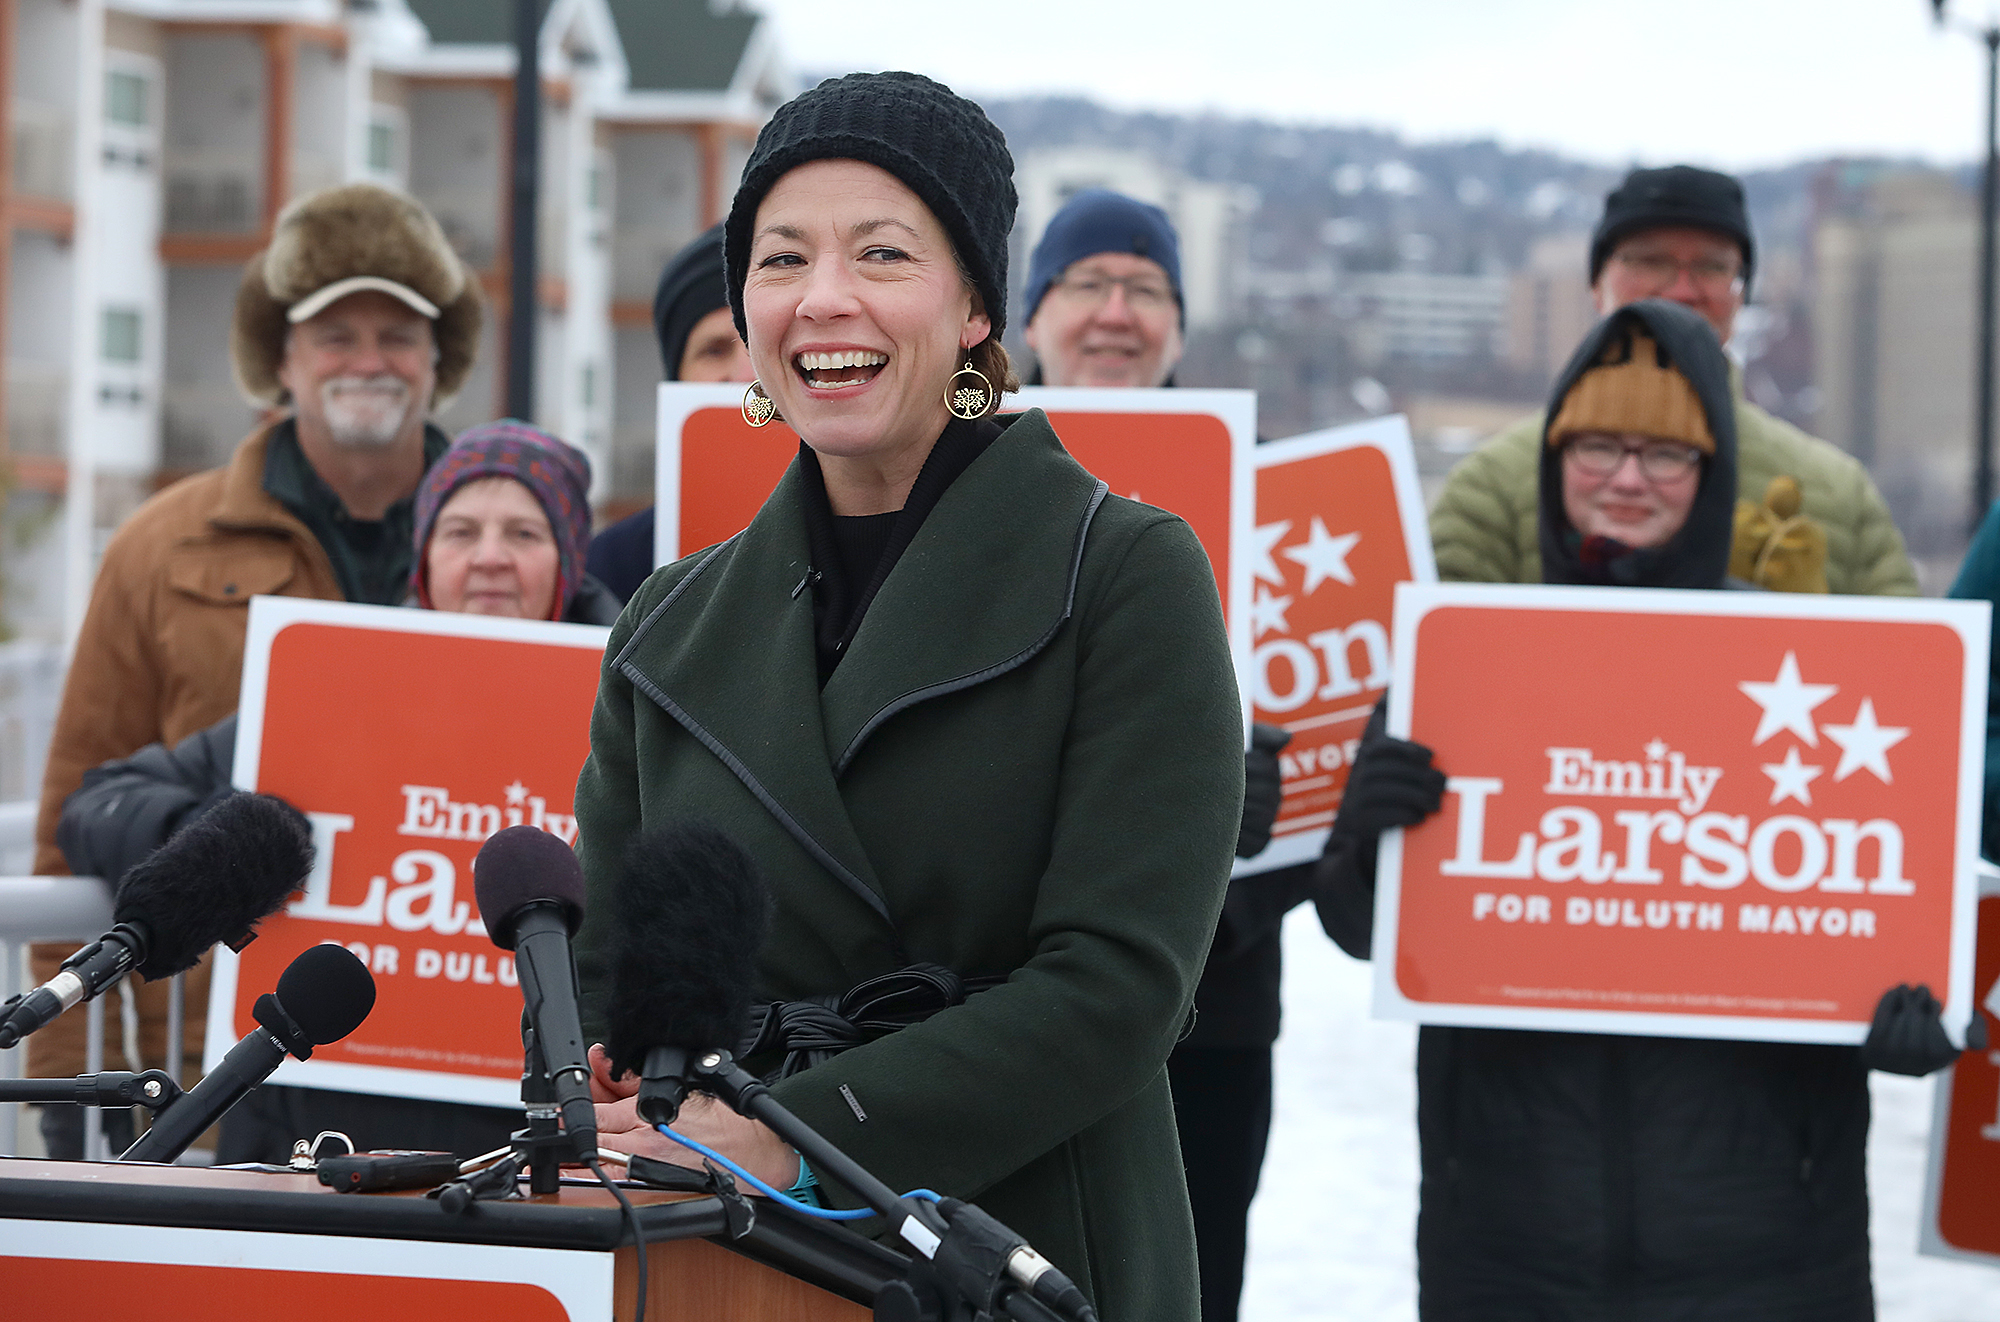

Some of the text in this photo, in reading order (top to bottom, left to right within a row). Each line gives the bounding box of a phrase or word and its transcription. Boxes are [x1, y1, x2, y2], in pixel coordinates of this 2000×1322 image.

[1254, 619, 1390, 714] on
[1544, 738, 1723, 814] Emily
[288, 811, 487, 936] La
[1441, 777, 1916, 896] Larson
[1474, 893, 1877, 938] FOR DULUTH MAYOR
[415, 947, 521, 987] DULU
